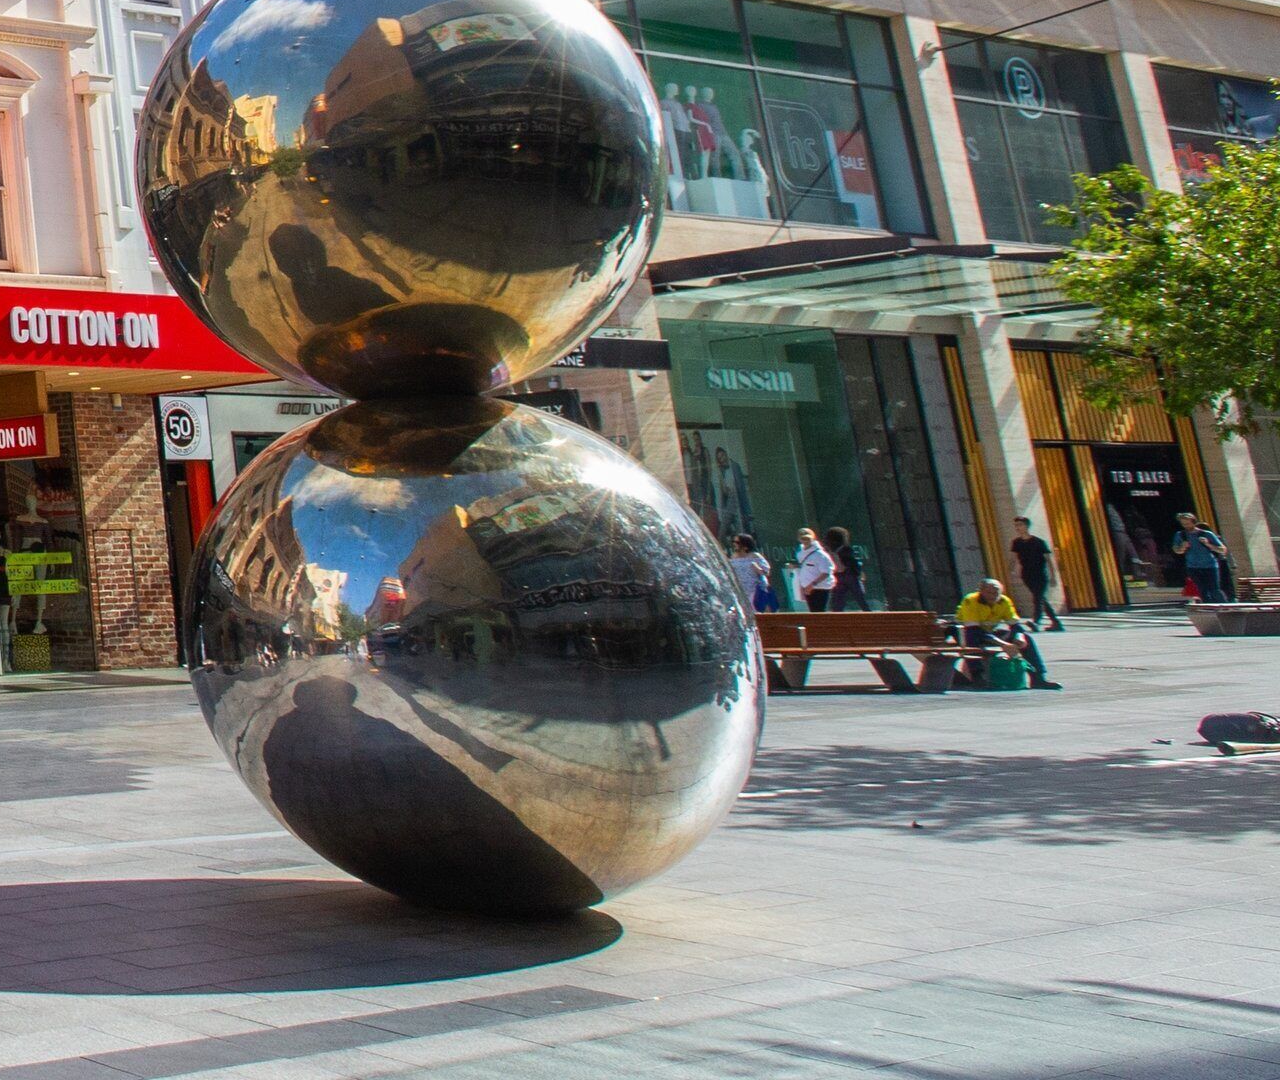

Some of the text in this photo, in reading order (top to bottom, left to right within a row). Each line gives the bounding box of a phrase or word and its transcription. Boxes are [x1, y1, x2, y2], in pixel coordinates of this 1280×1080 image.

[841, 155, 867, 171] SALE
[9, 306, 160, 350] COTTON ON
[706, 366, 795, 394] sussan
[18, 426, 38, 448] ON
[169, 415, 191, 439] 50
[1109, 470, 1173, 484] TED BAKER
